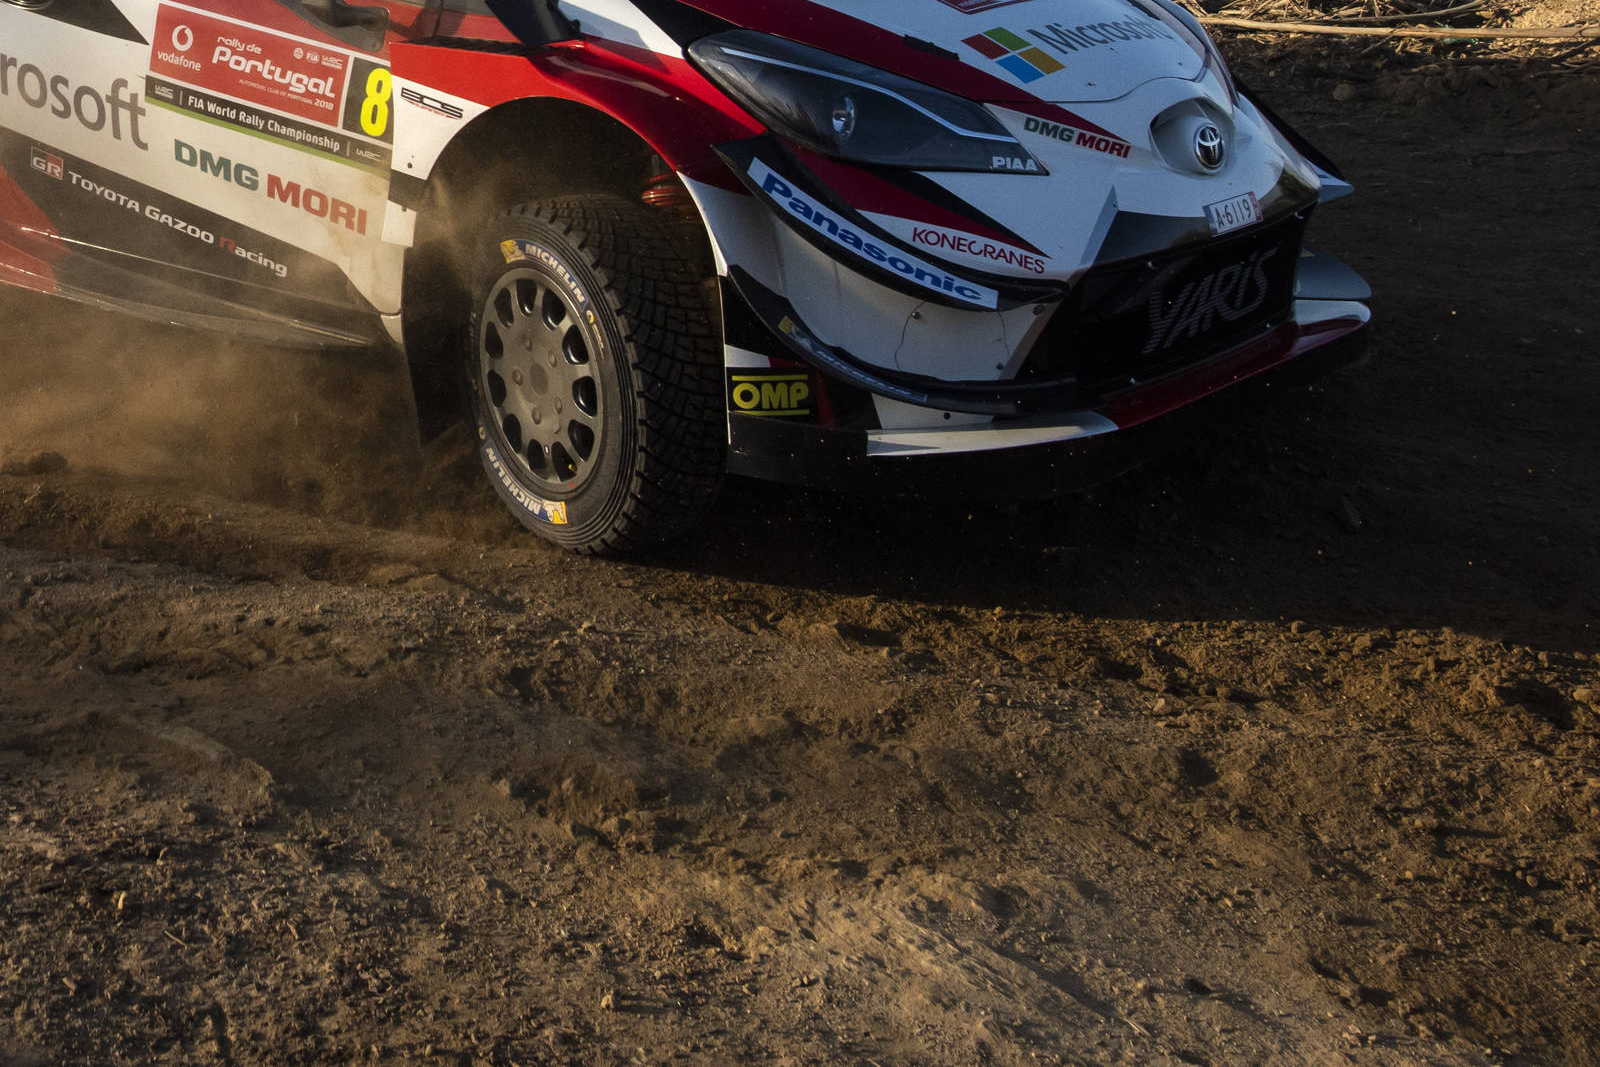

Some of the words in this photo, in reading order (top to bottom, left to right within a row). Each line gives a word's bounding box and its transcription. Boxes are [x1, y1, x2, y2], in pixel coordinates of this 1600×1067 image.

[157, 50, 202, 72] vodafone
[216, 36, 245, 52] rally
[246, 43, 262, 55] de
[1026, 14, 1175, 55] Microsoft
[211, 46, 336, 99] Portugal
[188, 95, 205, 112] FIA
[207, 101, 236, 120] World
[239, 110, 265, 133] Rally
[267, 120, 340, 152] Championship
[314, 98, 334, 111] 2018
[360, 67, 393, 137] 8
[991, 155, 1039, 172] PIAA
[1024, 117, 1074, 143] DMG
[1075, 132, 1131, 159] MORI
[174, 138, 260, 192] DMG
[266, 173, 367, 236] MORI
[32, 155, 62, 178] GR
[69, 170, 140, 213] TOYOTA
[144, 204, 215, 246] GAZOO
[219, 236, 287, 278] Racing
[762, 172, 982, 301] Panasonic
[525, 243, 586, 303] MICHELIN
[912, 227, 1046, 275] KONECRANES
[1142, 247, 1280, 354] YARIS
[732, 382, 809, 410] OMP
[485, 447, 542, 516] MICHELIN
